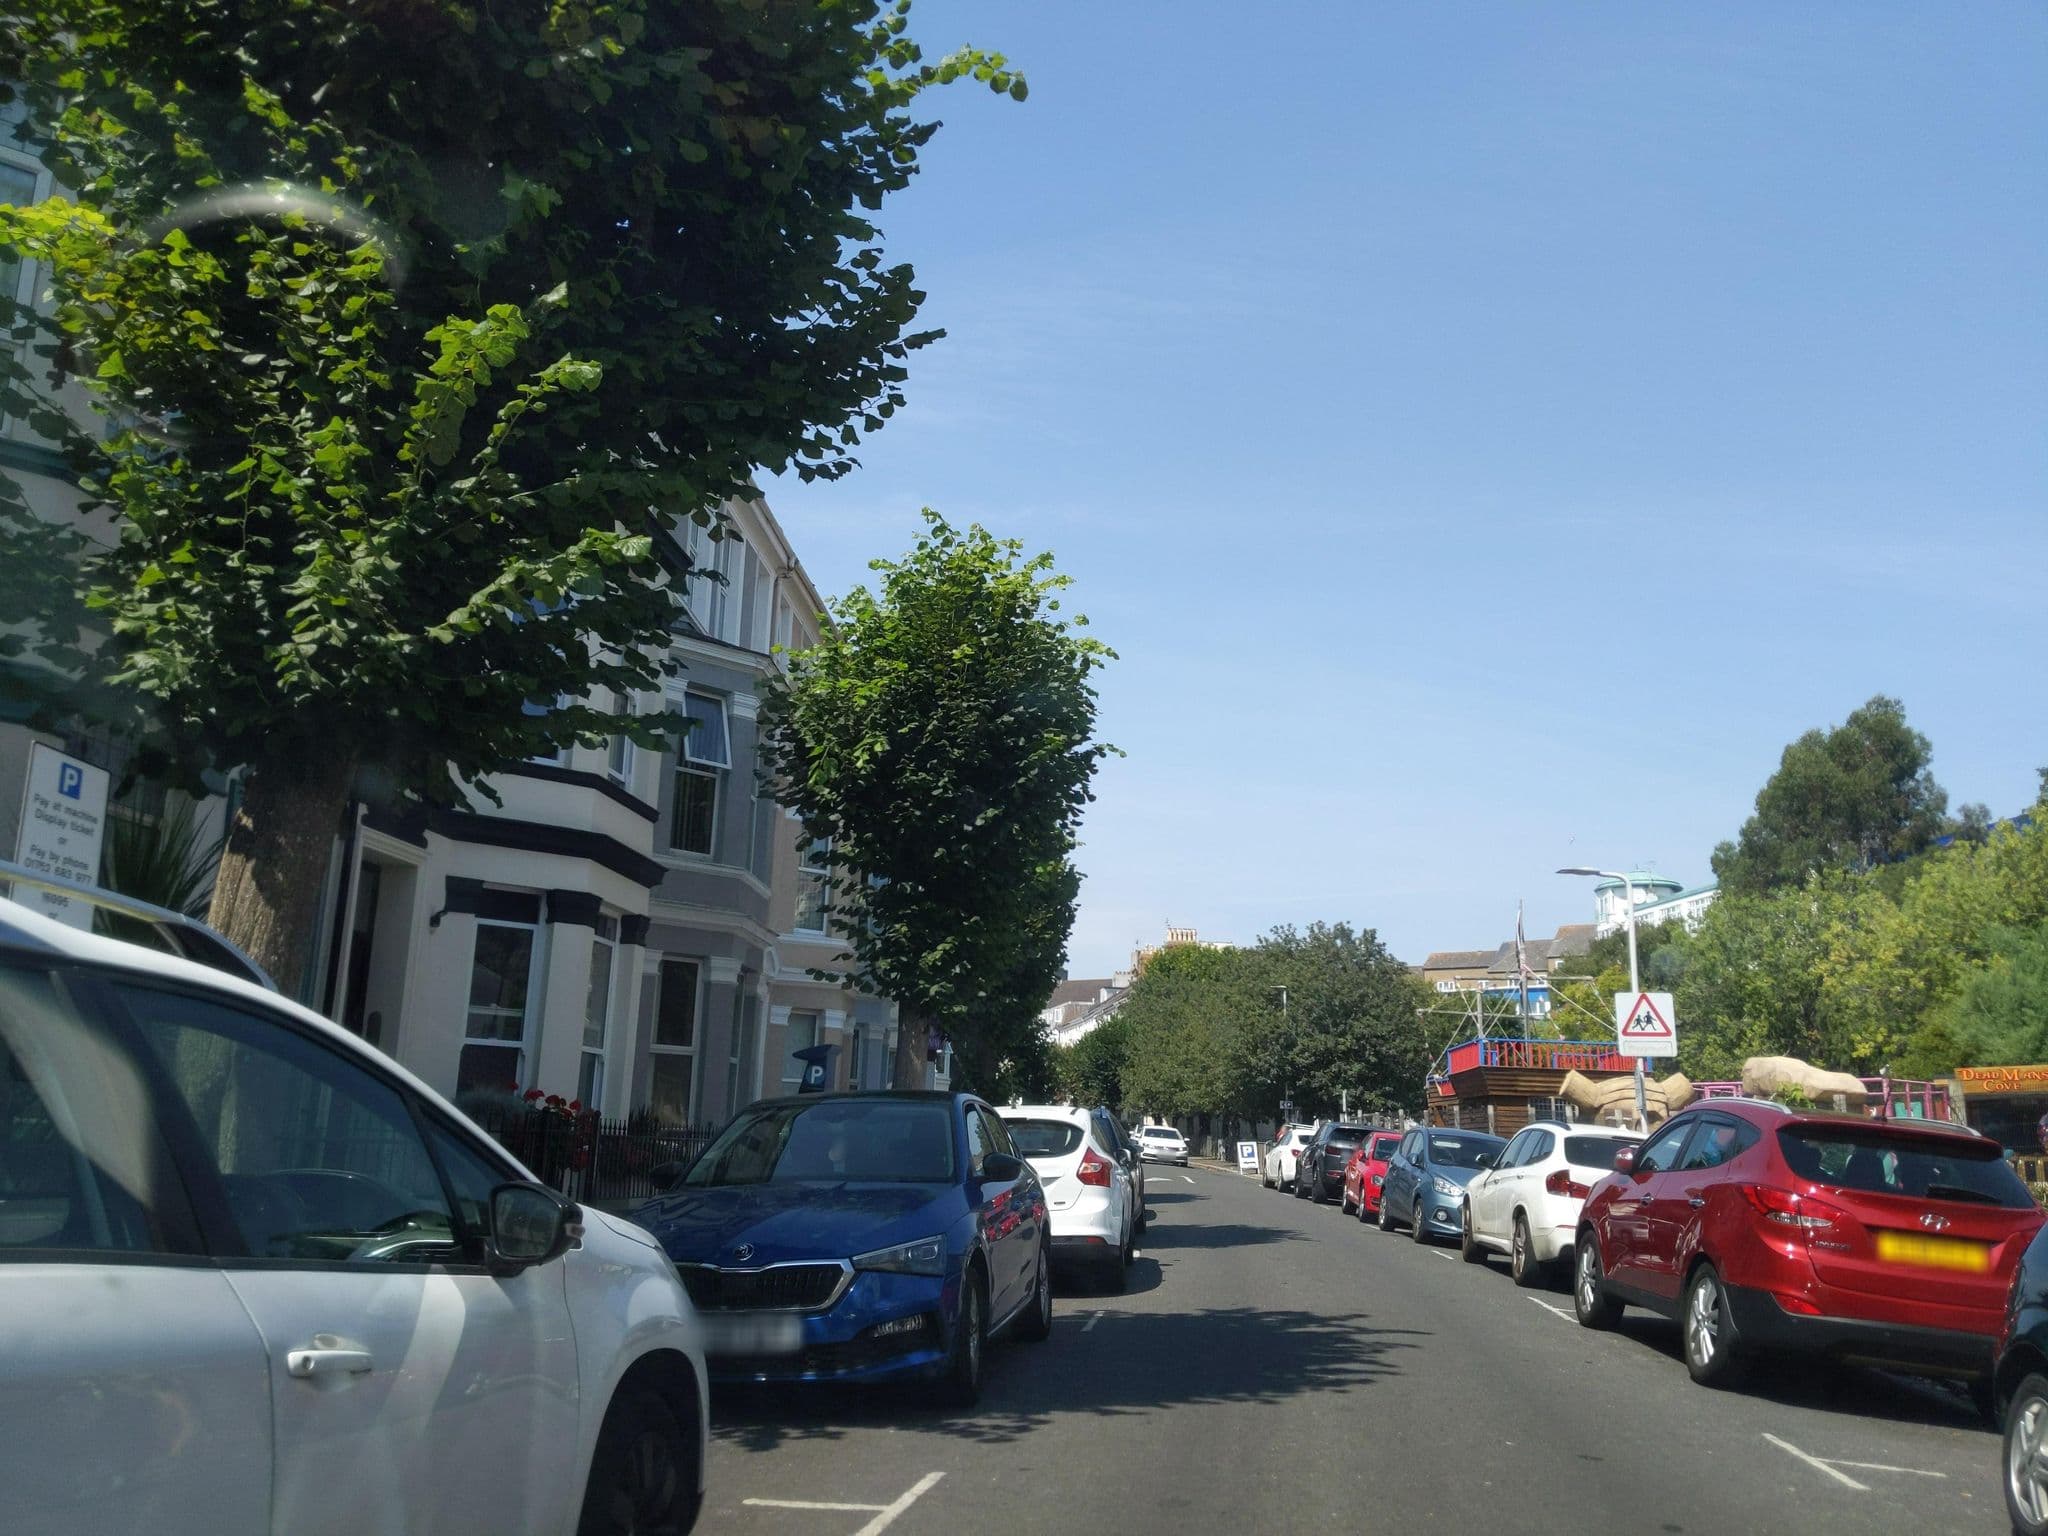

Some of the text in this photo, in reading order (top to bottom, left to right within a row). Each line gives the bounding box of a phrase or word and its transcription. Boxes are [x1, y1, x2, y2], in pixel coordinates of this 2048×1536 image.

[63, 766, 78, 792] P
[34, 793, 98, 824] Pay at machine
[34, 809, 95, 837] Display ticket
[58, 836, 67, 845] or
[30, 844, 90, 870] Pay by phone
[811, 1065, 823, 1084] P
[1242, 1145, 1252, 1157] P
